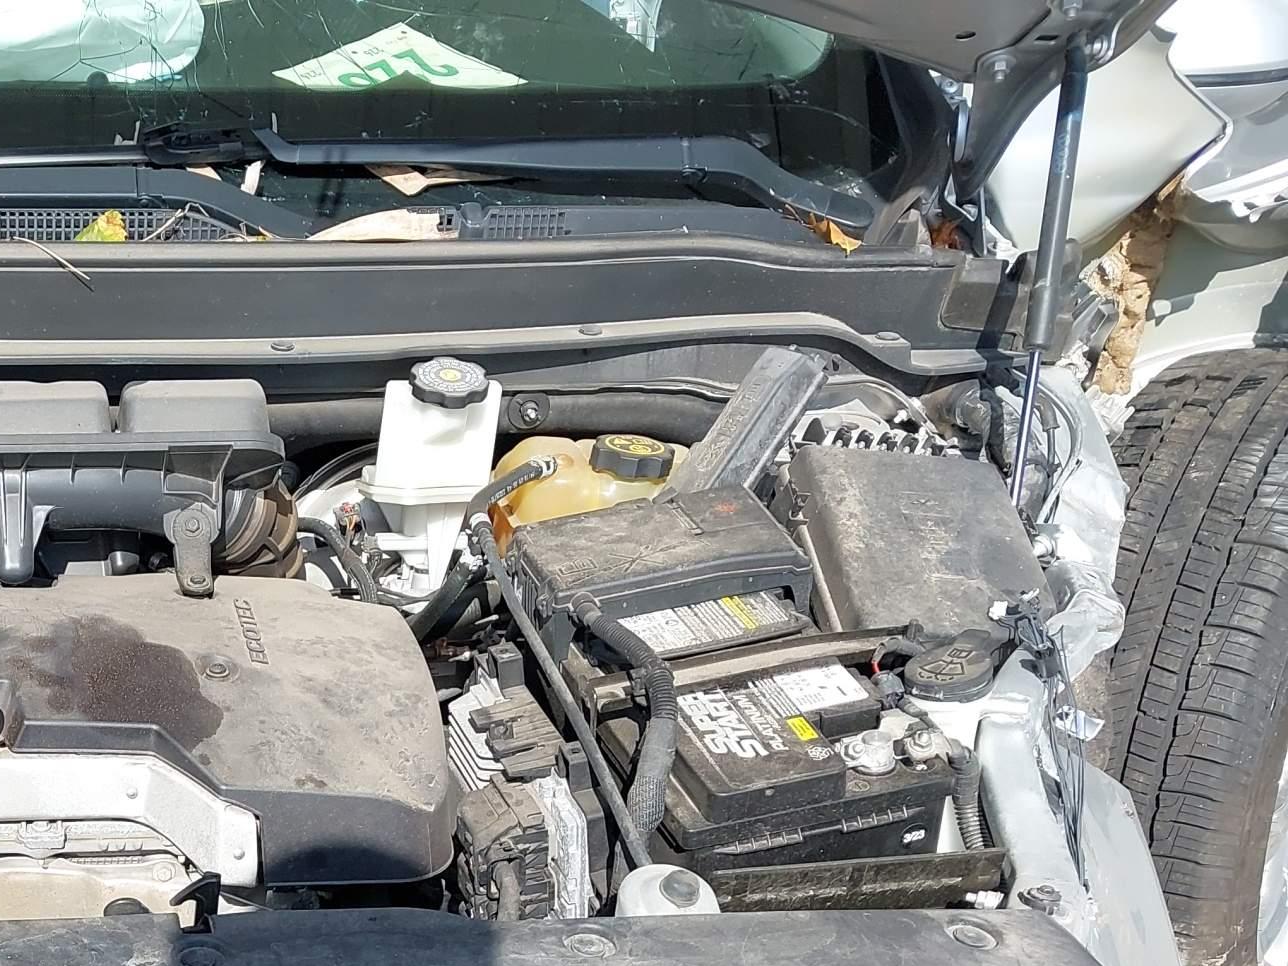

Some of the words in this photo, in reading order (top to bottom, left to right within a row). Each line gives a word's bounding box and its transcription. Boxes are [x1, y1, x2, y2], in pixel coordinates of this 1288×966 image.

[233, 599, 270, 666] ECOTEC
[676, 692, 733, 754] SUPER
[702, 692, 770, 759] START
[732, 694, 790, 752] PLATINUM
